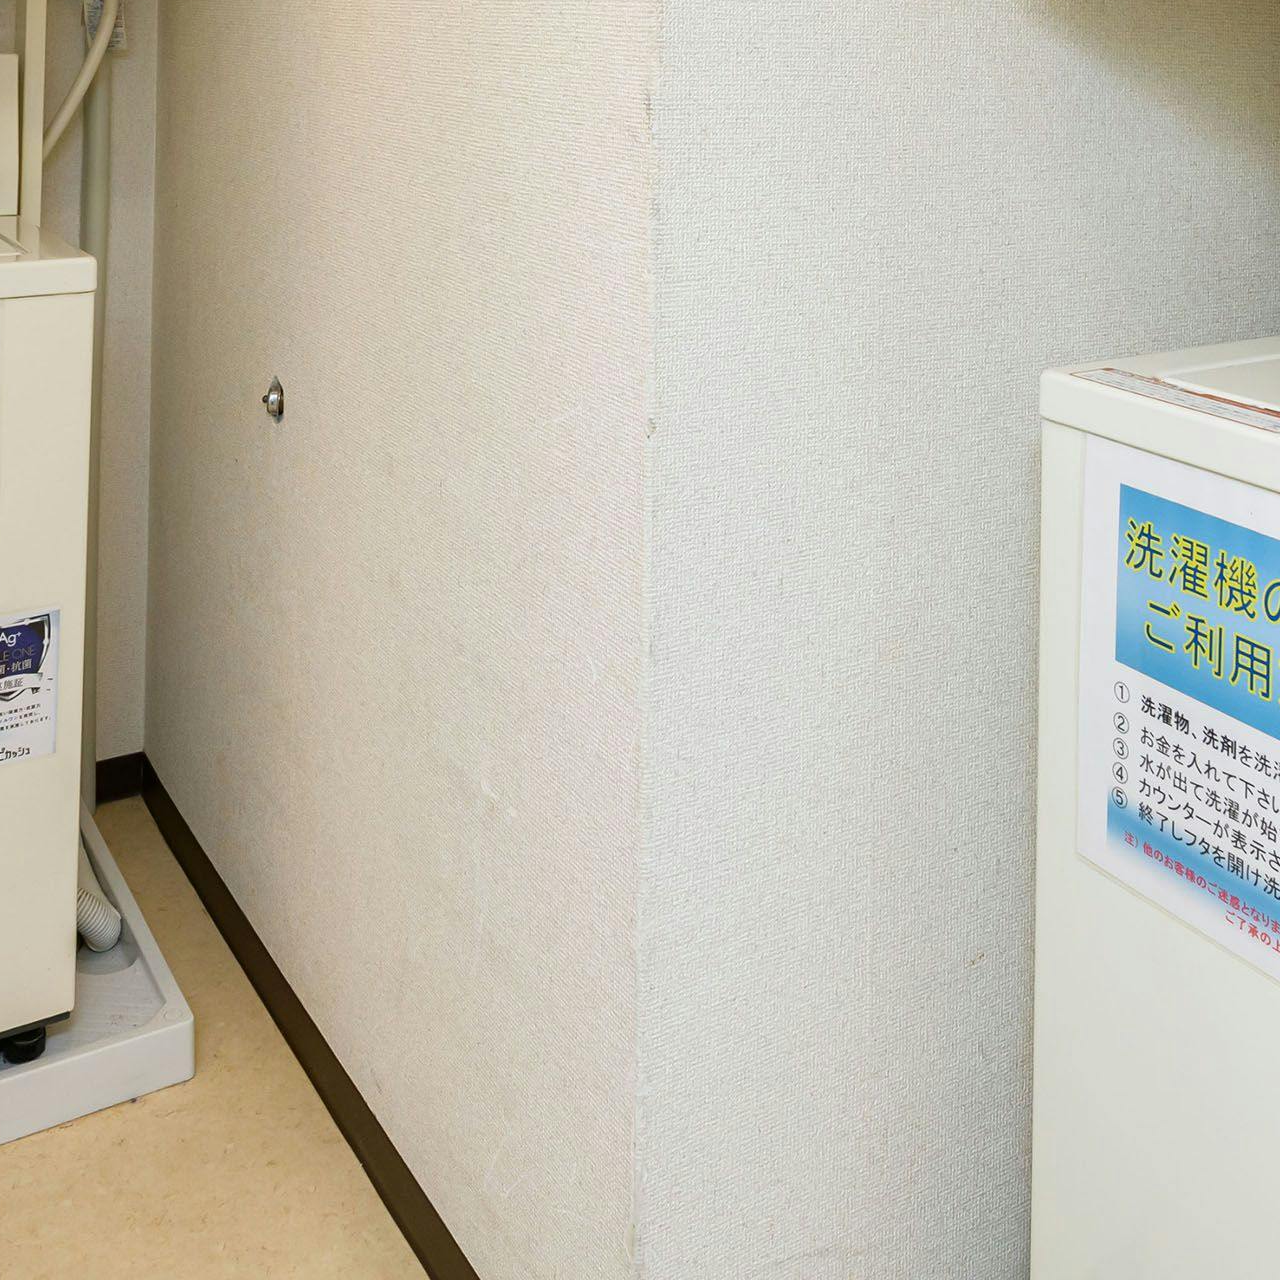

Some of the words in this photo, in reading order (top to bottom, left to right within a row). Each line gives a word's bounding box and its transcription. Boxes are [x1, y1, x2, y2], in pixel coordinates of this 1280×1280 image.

[1113, 681, 1131, 704] ①
[1112, 712, 1130, 734] ②
[1112, 738, 1129, 759] ③
[1111, 762, 1129, 784] ④
[1111, 787, 1128, 809] ⑤
